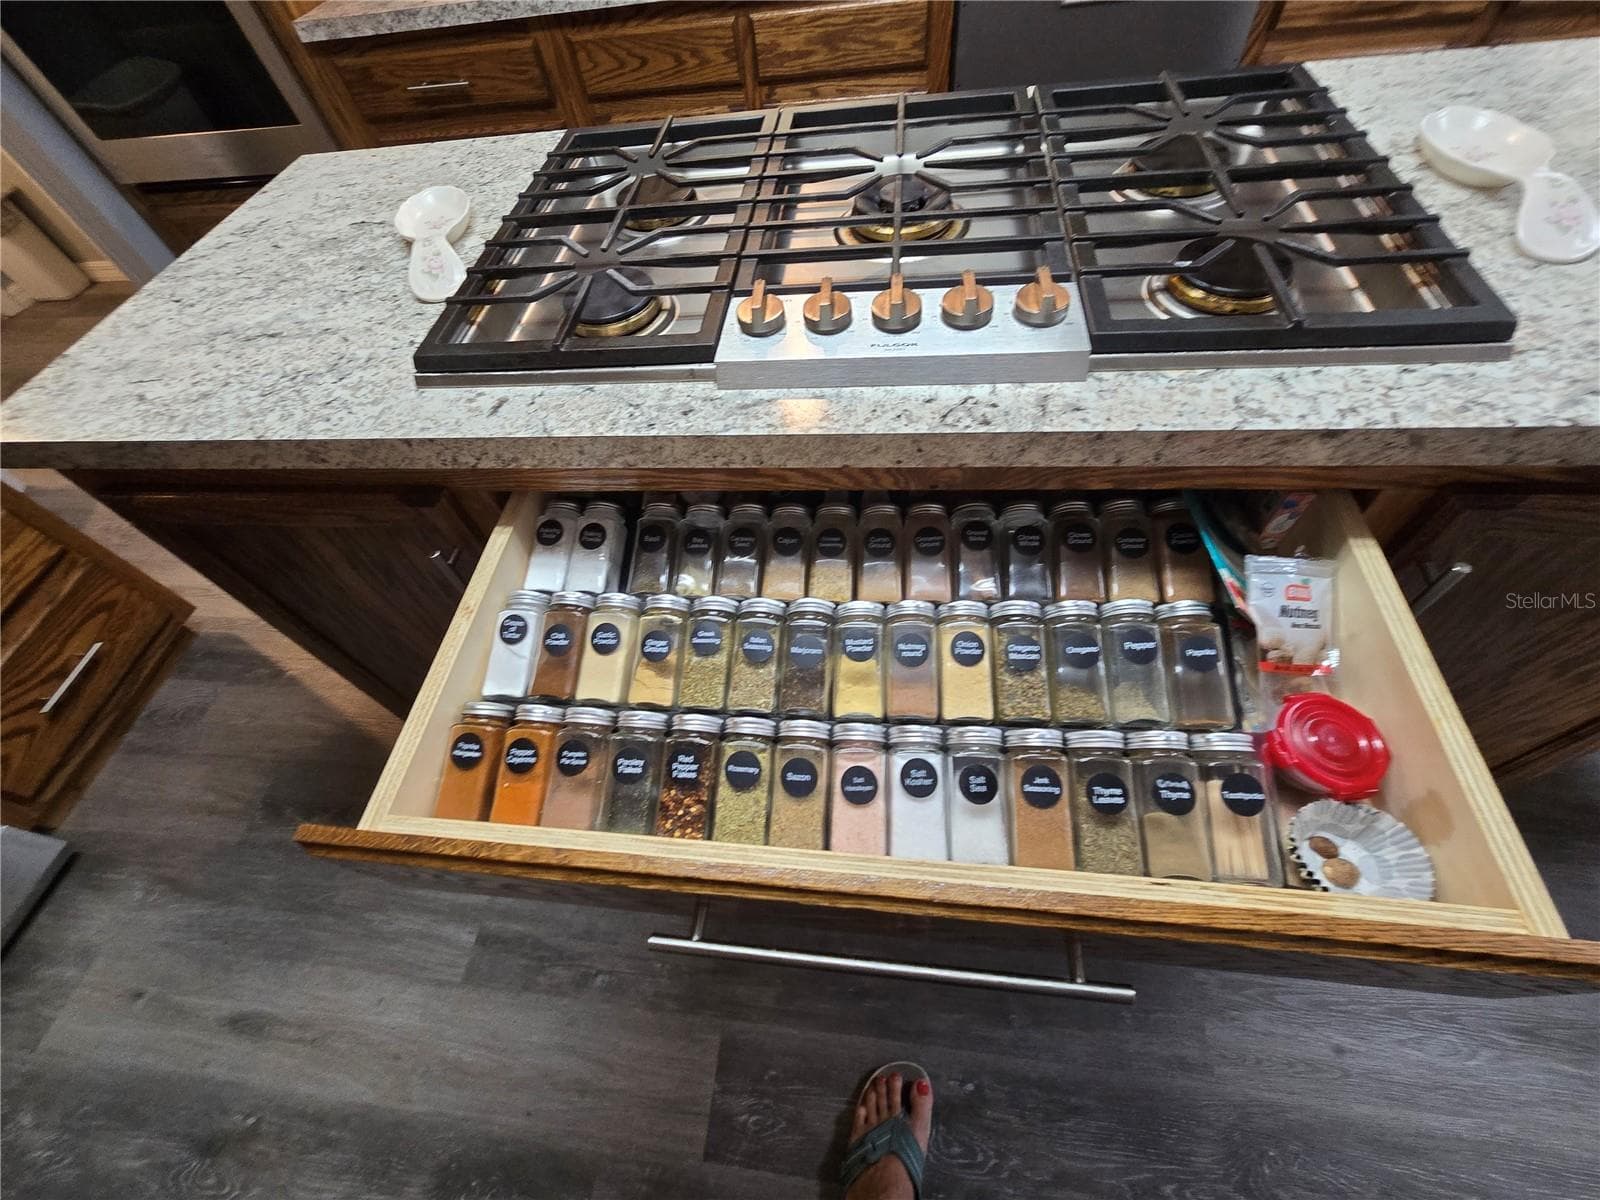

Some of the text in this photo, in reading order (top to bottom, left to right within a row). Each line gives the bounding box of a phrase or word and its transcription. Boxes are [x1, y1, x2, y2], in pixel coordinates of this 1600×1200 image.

[955, 640, 979, 648] Onion
[1007, 644, 1041, 653] Oregano
[954, 647, 983, 655] Powder
[1065, 646, 1099, 655] Oregano
[677, 754, 695, 763] Red
[904, 777, 935, 787] Kosher
[968, 776, 987, 784] Salt
[969, 784, 988, 793] Sea
[1092, 786, 1123, 797] Thyme
[1158, 789, 1191, 801] Thyme
